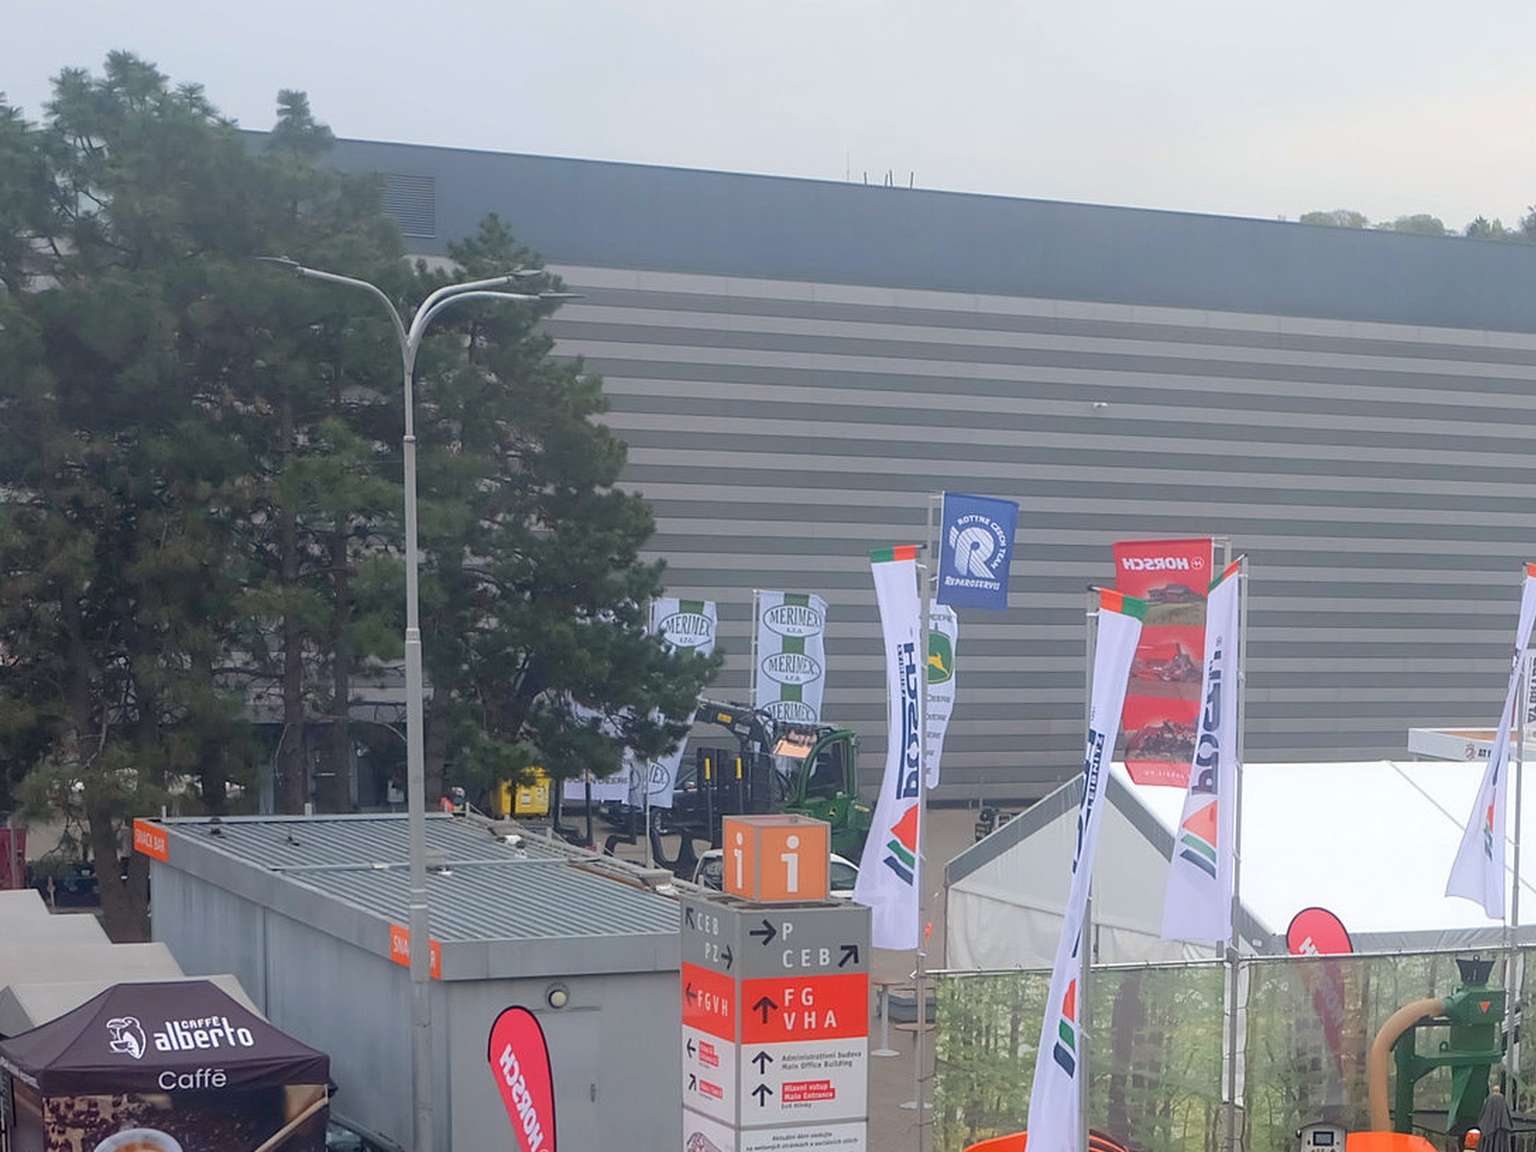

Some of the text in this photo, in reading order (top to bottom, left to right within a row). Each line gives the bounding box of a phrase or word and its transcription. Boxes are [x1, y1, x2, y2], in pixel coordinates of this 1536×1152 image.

[665, 617, 711, 637] MERIMEX
[769, 608, 822, 628] MERIMEX
[768, 658, 816, 674] MERIMEX
[153, 1017, 255, 1051] alberto
